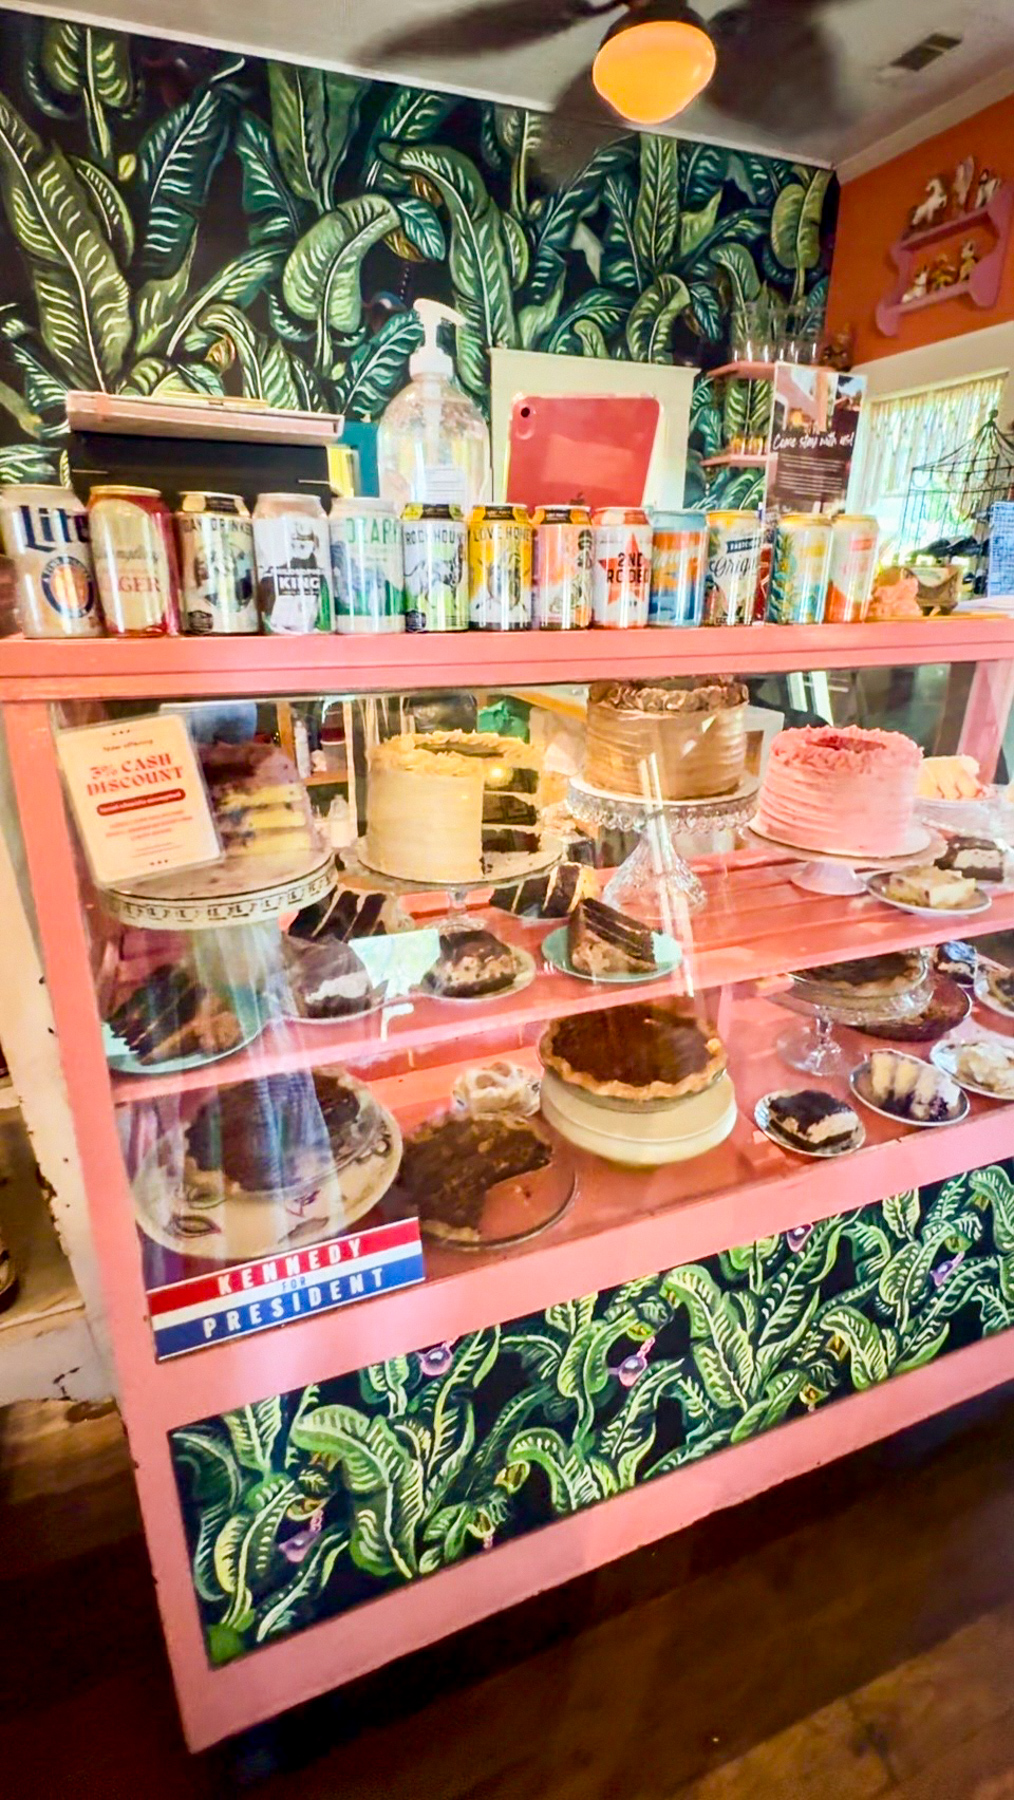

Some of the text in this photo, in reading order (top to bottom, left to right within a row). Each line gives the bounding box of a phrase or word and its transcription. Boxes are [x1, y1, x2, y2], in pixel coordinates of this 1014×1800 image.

[772, 433, 797, 450] Come
[799, 433, 819, 449] stay
[819, 431, 837, 447] with
[617, 552, 643, 568] 2ND
[279, 577, 320, 590] KING
[121, 753, 171, 773] CASH
[86, 766, 183, 796] DISCOUNT
[217, 1238, 361, 1296] KENNEDY
[282, 1276, 306, 1292] FOR
[203, 1267, 383, 1339] PRESIDENT
